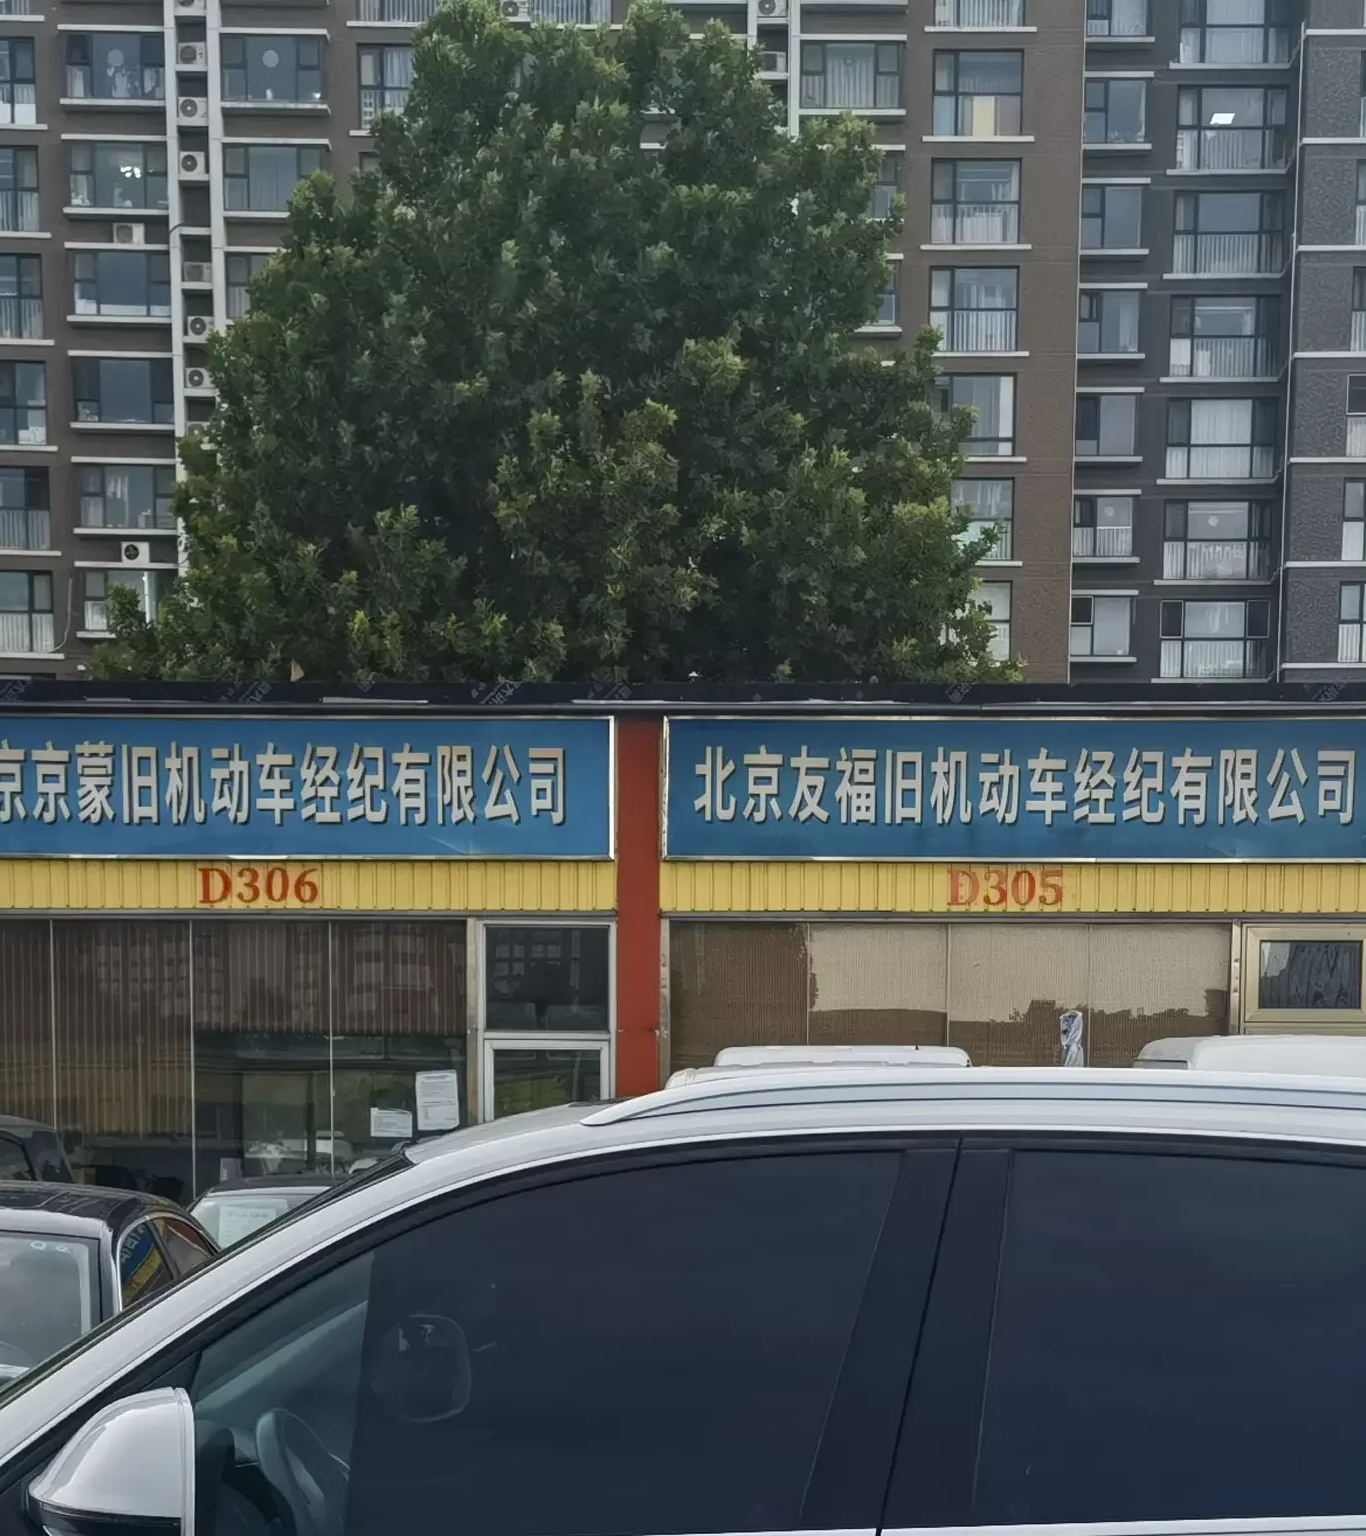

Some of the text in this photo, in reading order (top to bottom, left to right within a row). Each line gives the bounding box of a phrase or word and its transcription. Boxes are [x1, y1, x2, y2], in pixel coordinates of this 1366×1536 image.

[694, 745, 1357, 826] 北京友福旧机动车经纪有限公司
[198, 866, 320, 905] D306
[946, 867, 1065, 907] D305
